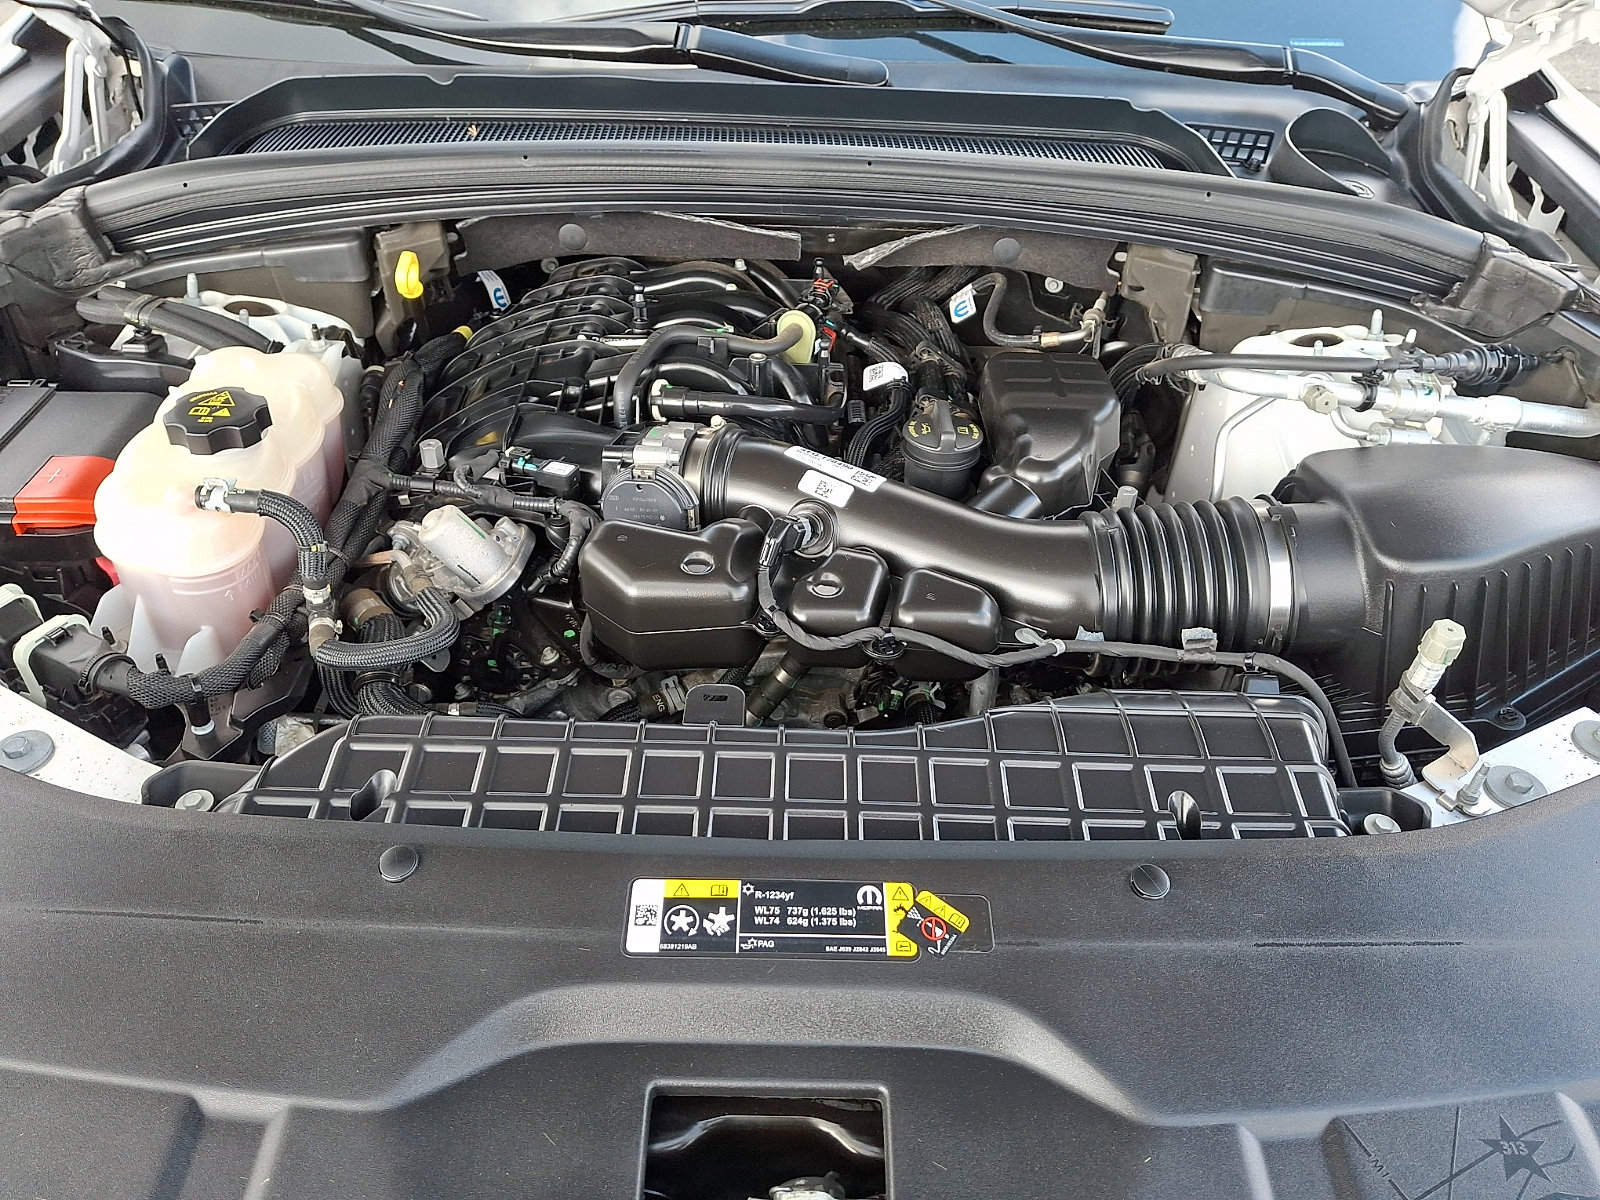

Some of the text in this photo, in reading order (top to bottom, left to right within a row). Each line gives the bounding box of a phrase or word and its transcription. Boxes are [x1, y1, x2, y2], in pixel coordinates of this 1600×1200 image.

[652, 694, 666, 713] ENG
[754, 890, 794, 902] R-1234yf
[754, 905, 857, 918] WL75 737g (1.625 lbs)
[753, 915, 857, 928] WL74 624g (1.375 lbs)
[757, 940, 775, 948] PAG
[1501, 1141, 1529, 1156] 313
